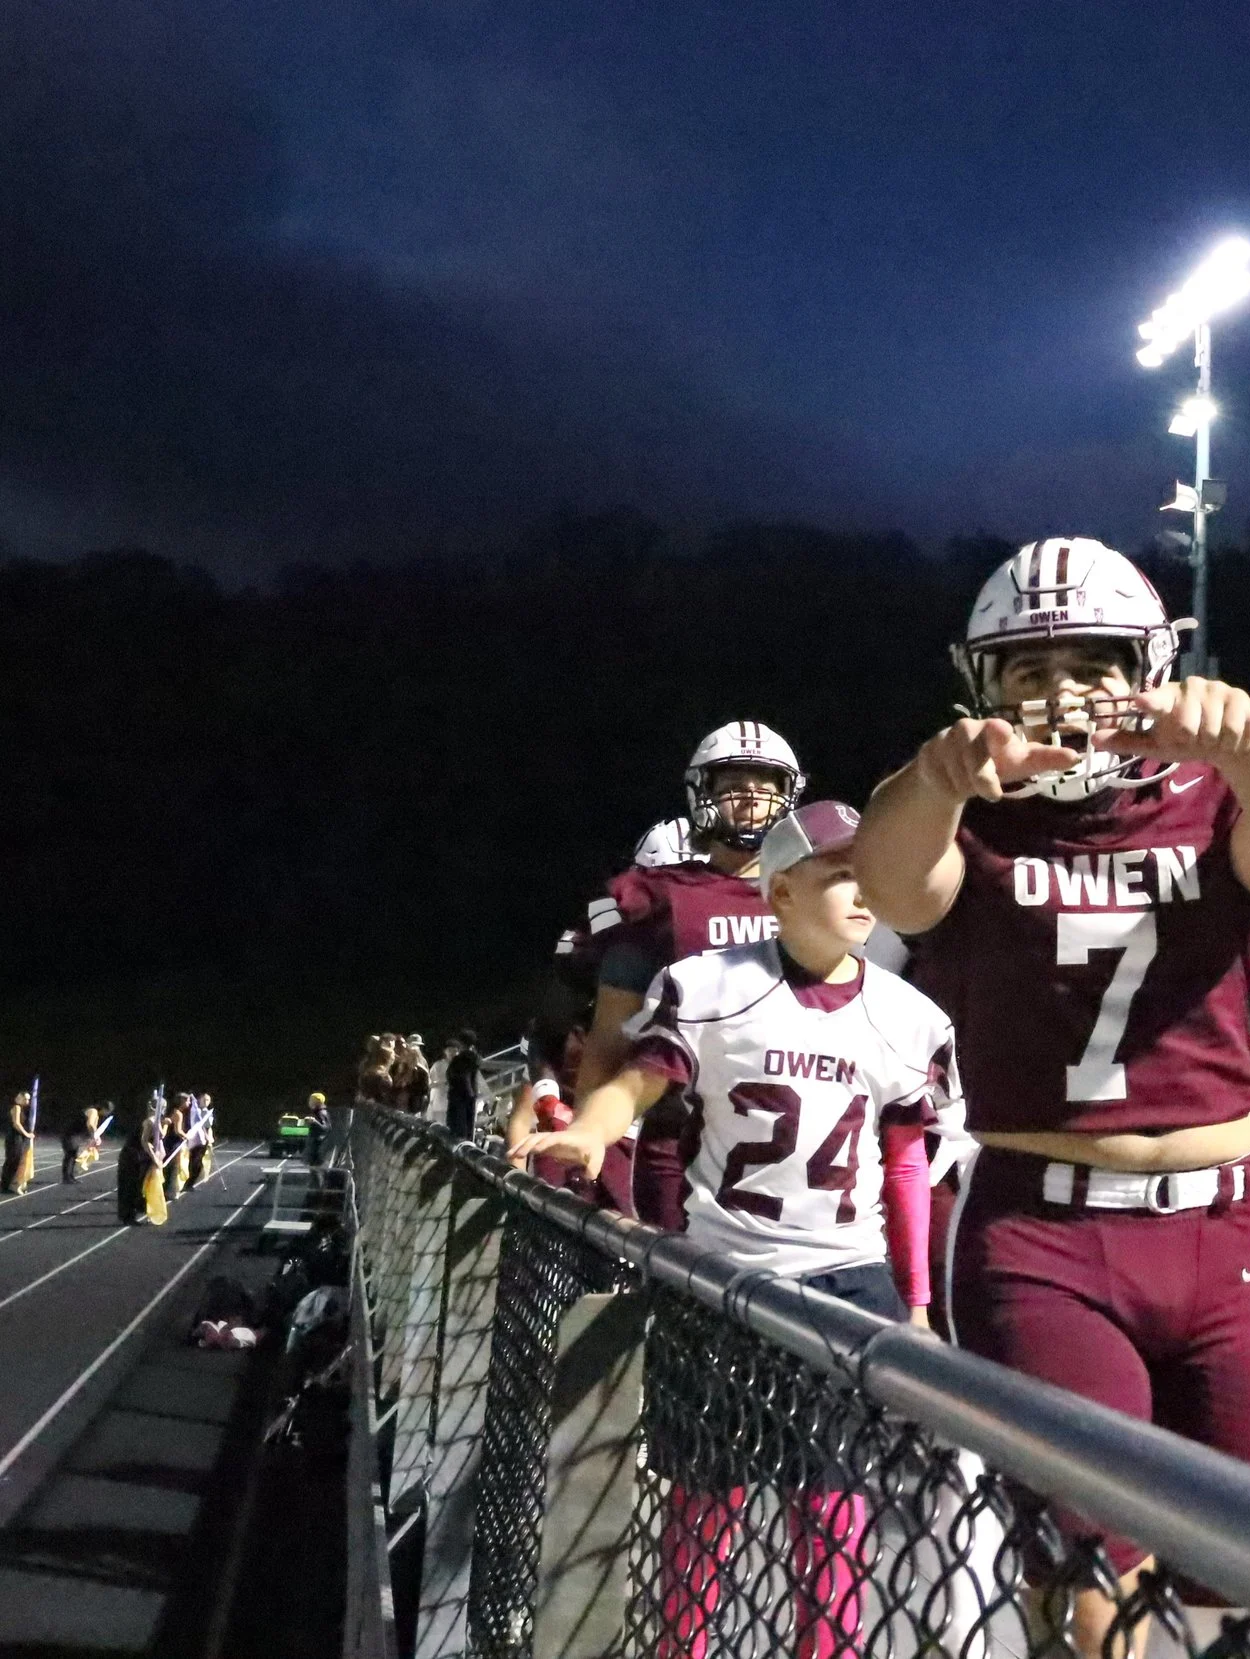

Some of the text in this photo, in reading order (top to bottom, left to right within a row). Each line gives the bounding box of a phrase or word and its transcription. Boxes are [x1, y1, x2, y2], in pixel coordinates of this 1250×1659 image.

[1030, 610, 1069, 625] OWEN
[1014, 845, 1200, 907] OWEN
[709, 915, 779, 946] OWE
[1056, 912, 1158, 1101] 7
[764, 1049, 856, 1085] OWEN
[719, 1081, 869, 1224] 24
